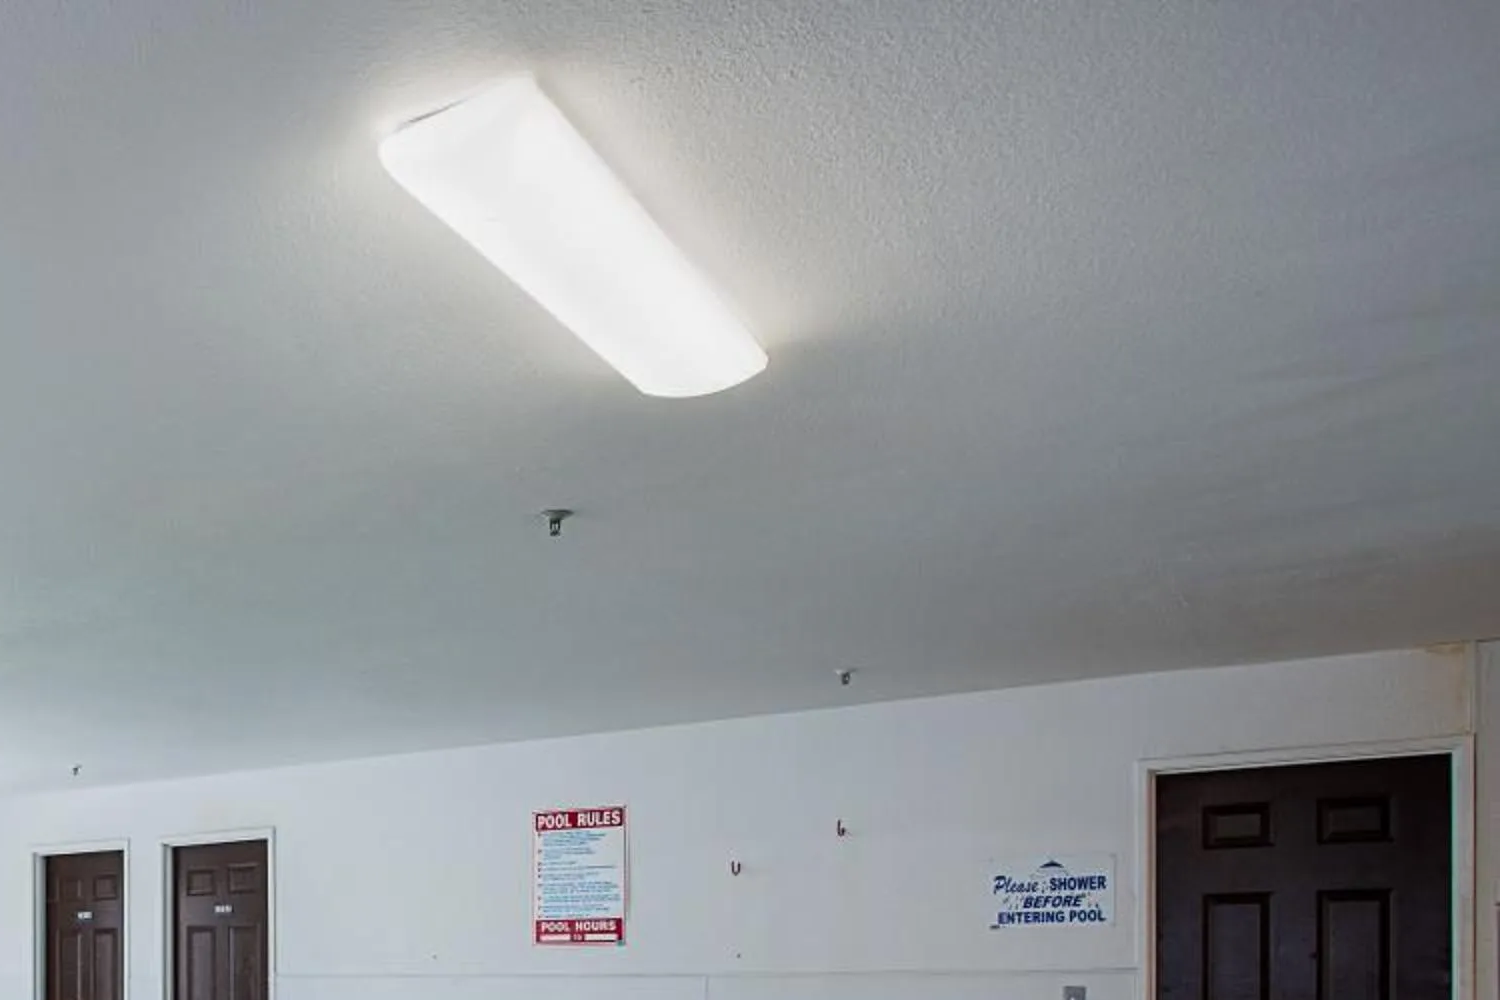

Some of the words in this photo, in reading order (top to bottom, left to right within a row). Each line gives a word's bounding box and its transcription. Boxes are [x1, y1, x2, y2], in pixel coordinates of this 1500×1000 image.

[537, 814, 573, 829] POOL
[577, 811, 621, 827] RULES
[993, 875, 1039, 895] Please
[1049, 876, 1107, 892] SHOWER
[1023, 895, 1082, 909] BEFORE
[998, 911, 1065, 924] ENTERING
[1069, 909, 1107, 922] POOL
[541, 921, 571, 933] POOL
[575, 920, 617, 932] HOURS
